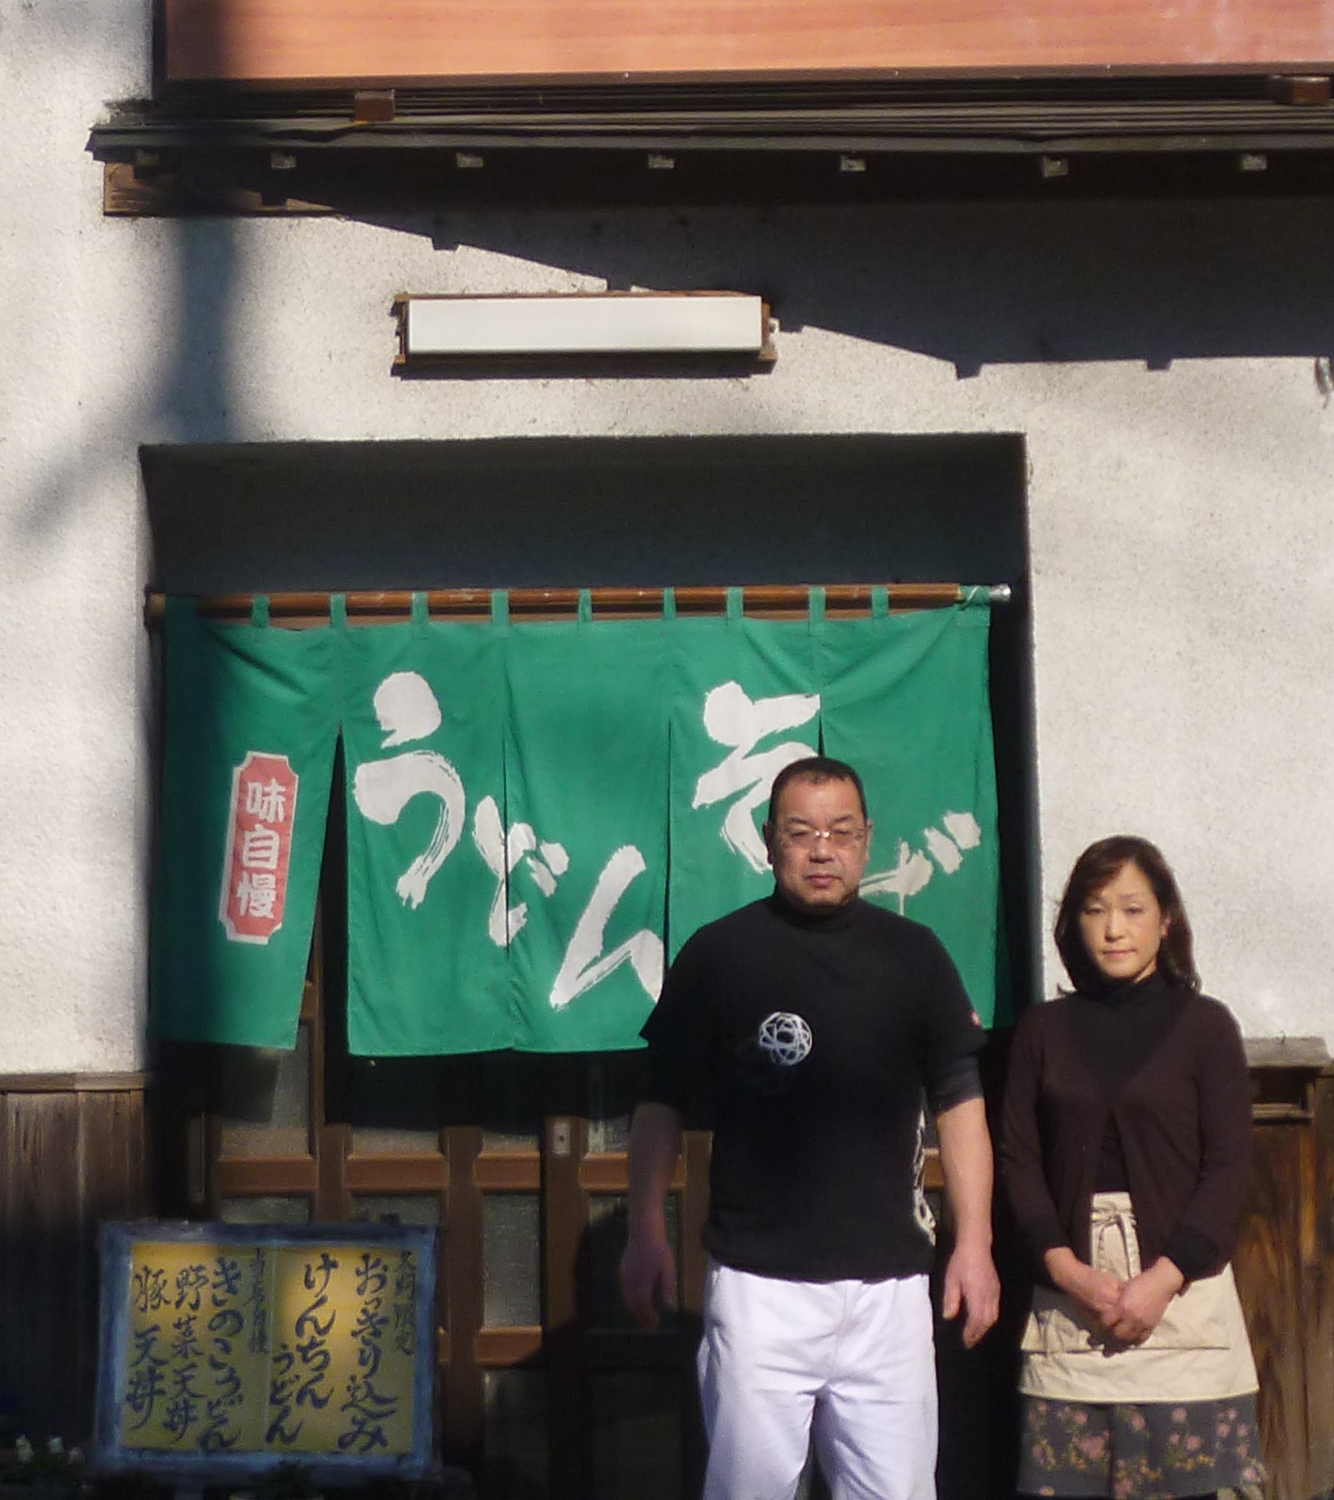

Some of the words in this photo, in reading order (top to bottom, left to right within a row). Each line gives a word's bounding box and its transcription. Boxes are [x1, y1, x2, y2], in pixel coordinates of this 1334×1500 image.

[235, 777, 287, 919] 味自慢
[353, 670, 665, 1010] うどん
